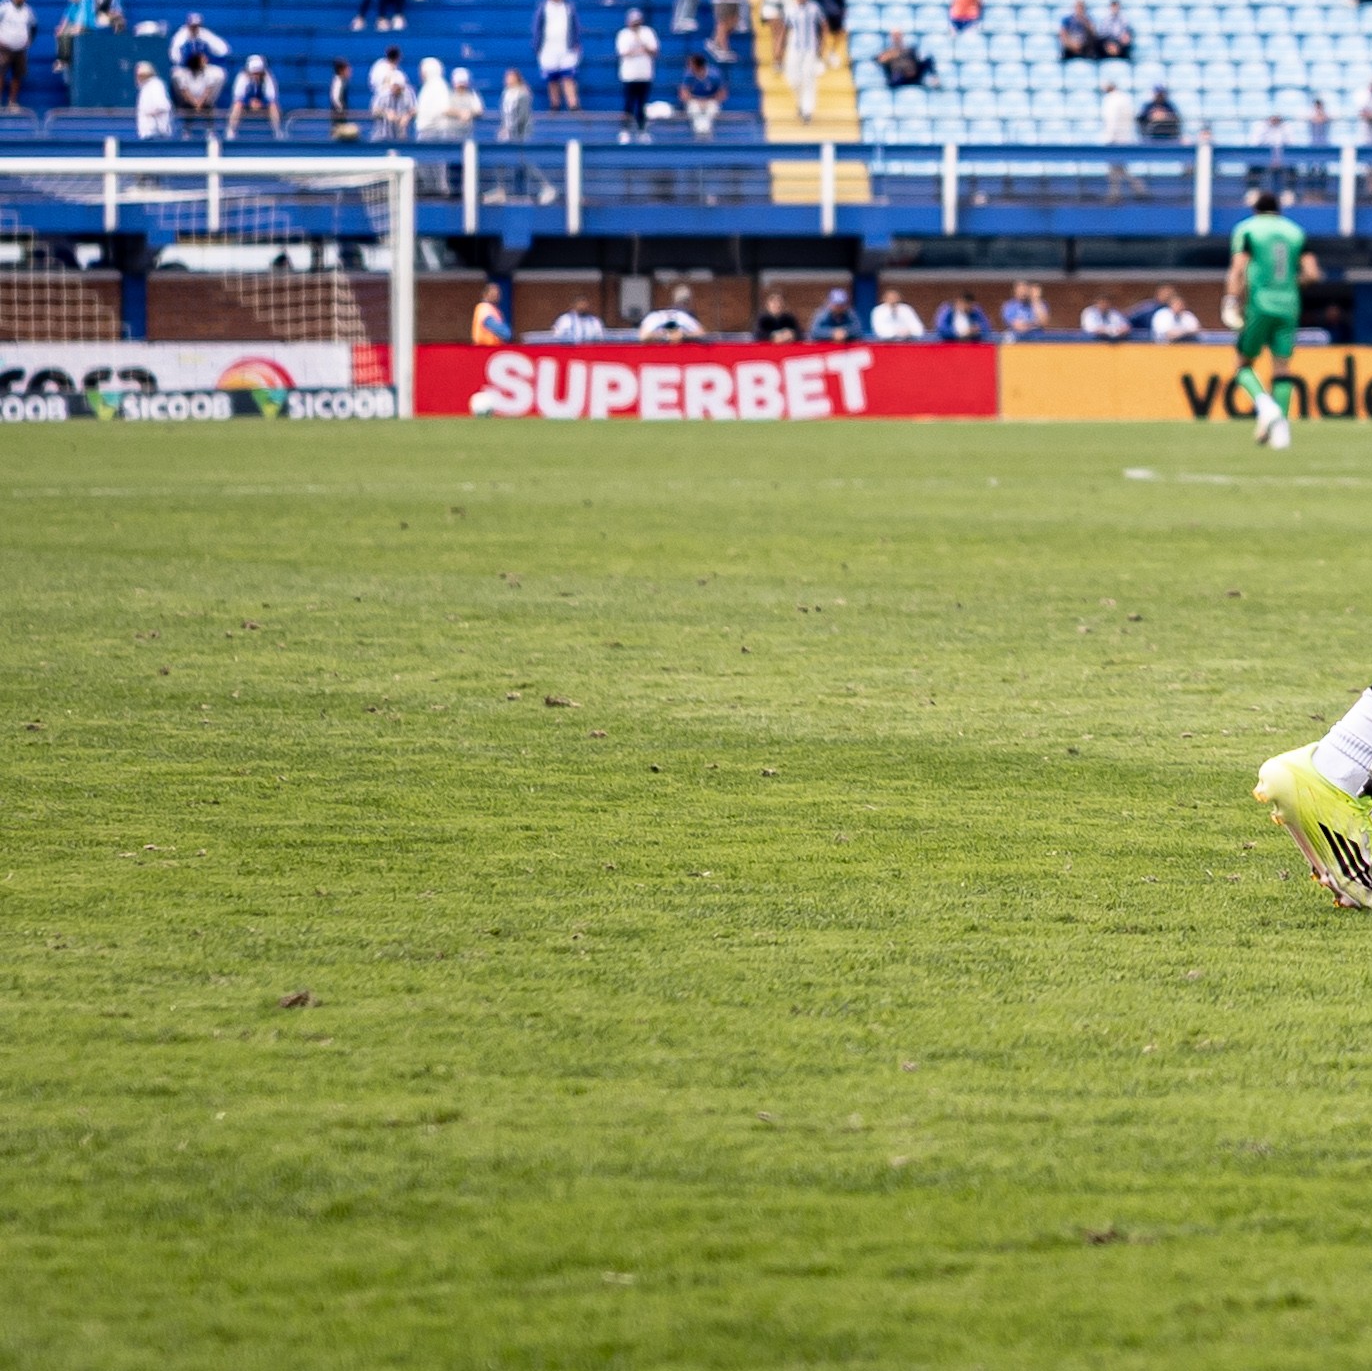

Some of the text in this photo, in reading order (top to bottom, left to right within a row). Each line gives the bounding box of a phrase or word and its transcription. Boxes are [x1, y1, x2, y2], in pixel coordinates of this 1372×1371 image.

[486, 349, 875, 421] SUPERBET
[123, 393, 233, 421] SICOOB
[287, 389, 394, 419] SICOOB
